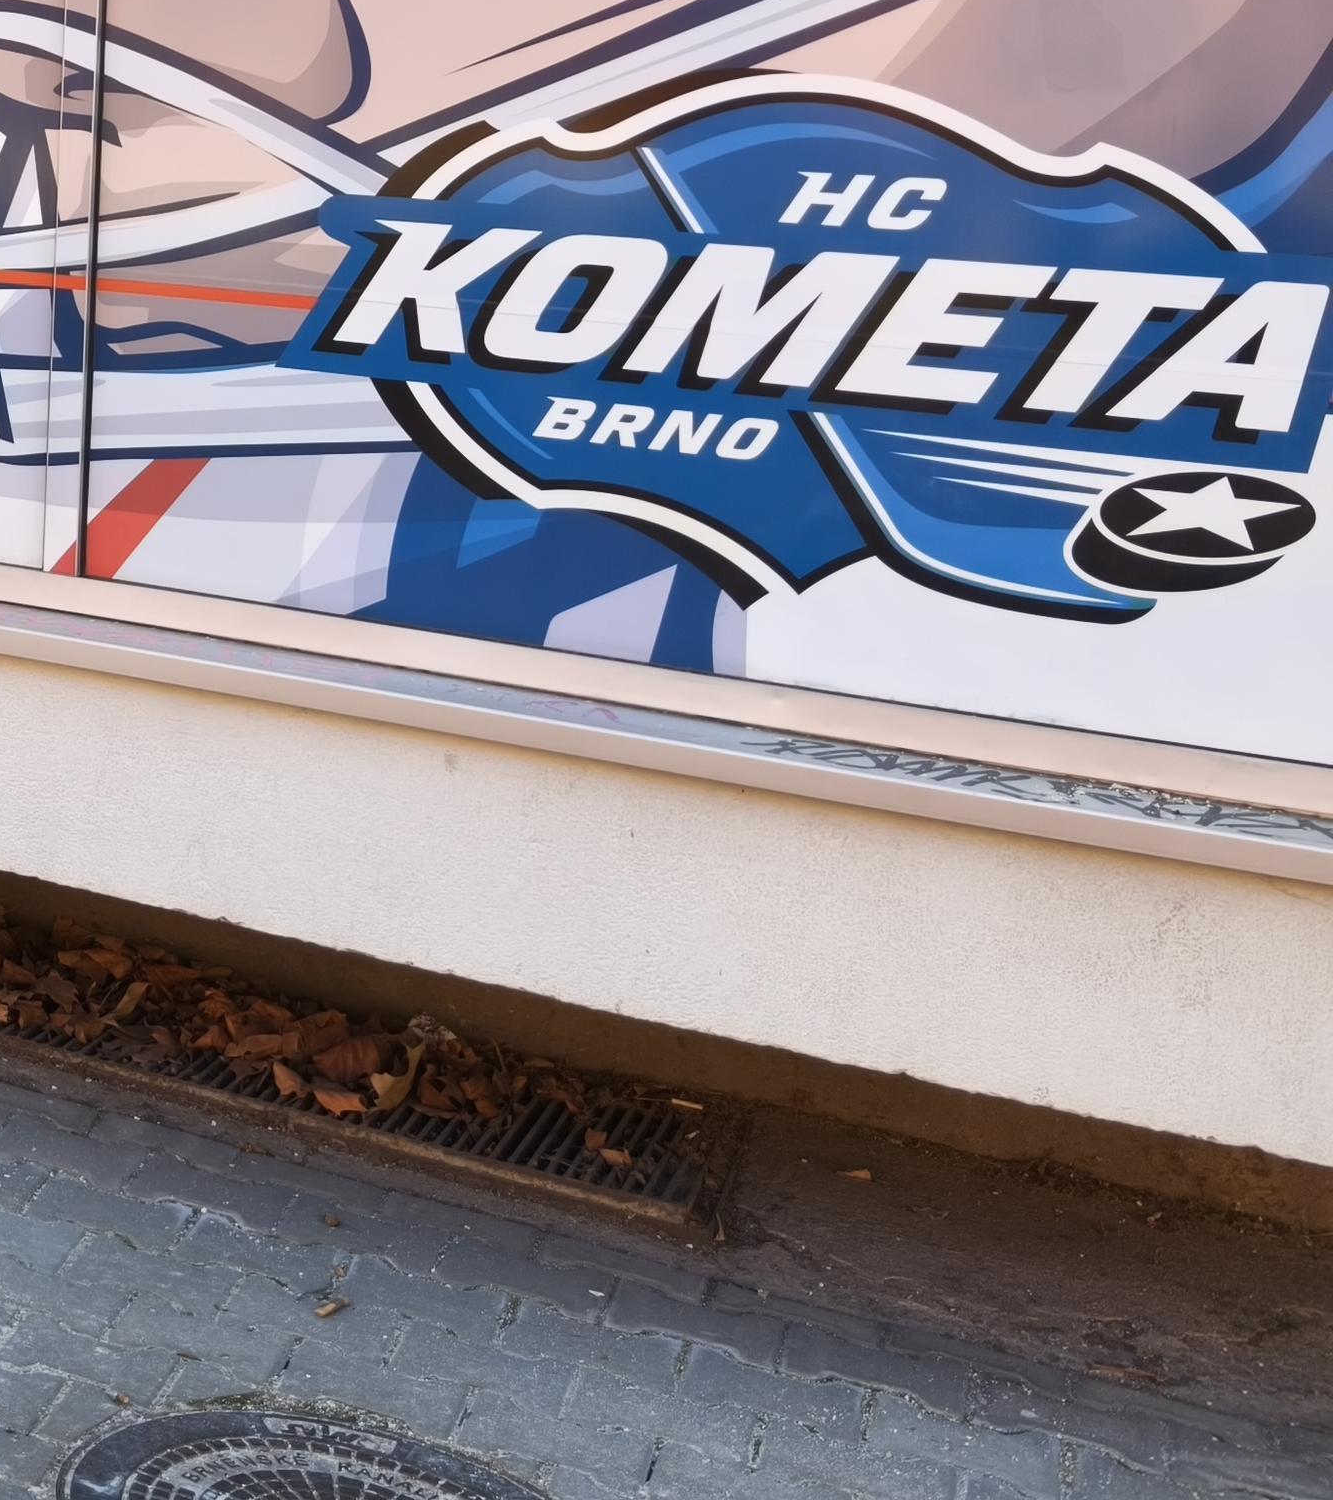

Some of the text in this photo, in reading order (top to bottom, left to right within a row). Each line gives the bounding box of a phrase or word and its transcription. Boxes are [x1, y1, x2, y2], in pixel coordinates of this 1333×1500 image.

[778, 169, 948, 230] HC
[332, 218, 1331, 434] KOMETA
[532, 395, 780, 461] BRNO
